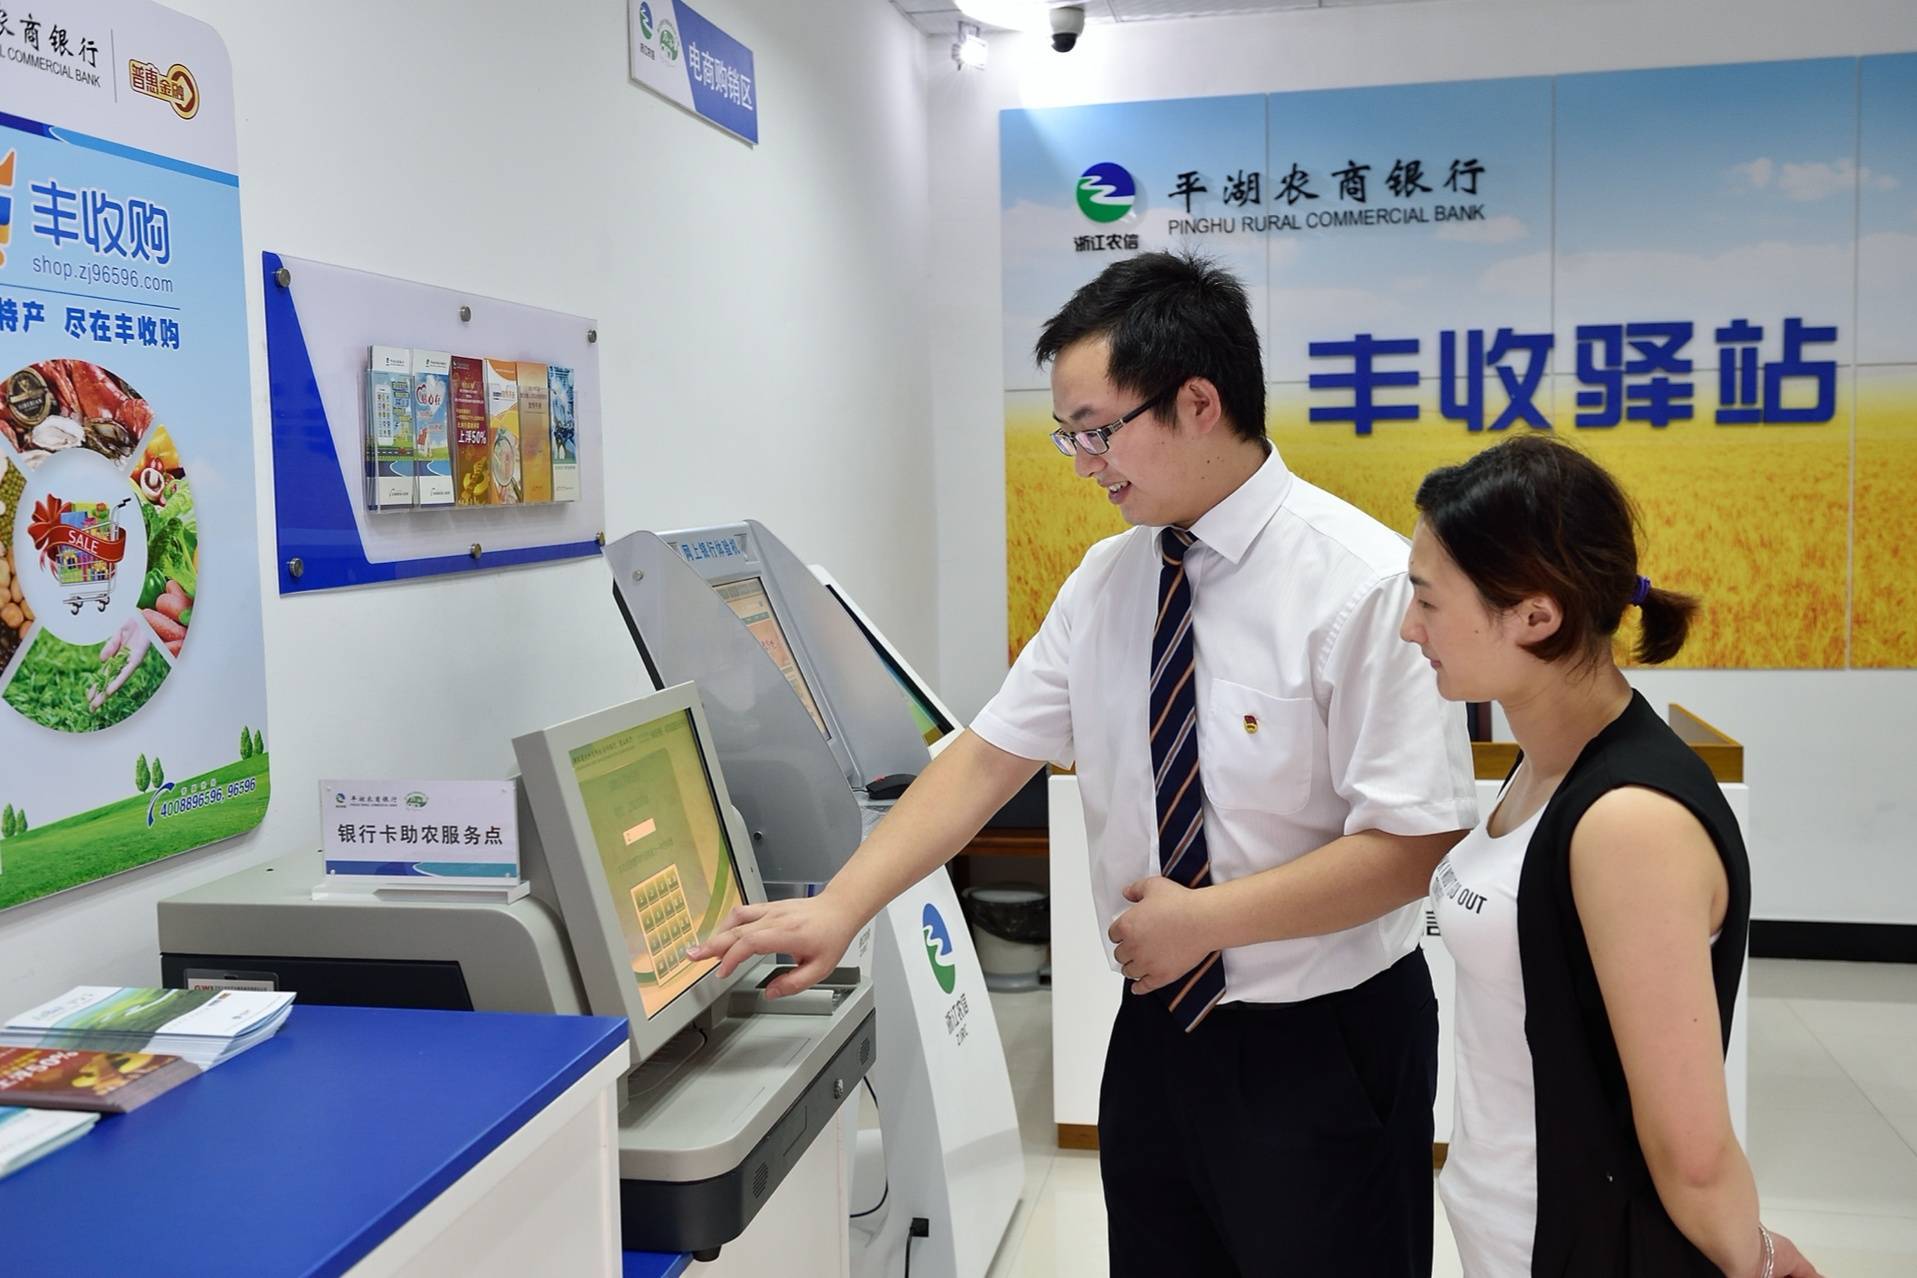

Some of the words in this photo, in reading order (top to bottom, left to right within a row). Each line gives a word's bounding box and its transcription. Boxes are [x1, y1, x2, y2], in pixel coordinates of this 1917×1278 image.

[7, 47, 74, 80] COMMERCIAL
[75, 69, 101, 88] BANK
[131, 63, 185, 101] 普惠金融
[688, 42, 754, 111] 电商购销区
[1168, 159, 1487, 214] 平湖农商银行
[31, 181, 172, 265] 丰收购
[1168, 218, 1236, 236] PINGHU
[1242, 214, 1301, 231] RURAL
[1306, 206, 1430, 229] COMMERCIAL
[1435, 204, 1487, 222] BANK
[1073, 233, 1139, 252] 浙江农信
[32, 255, 174, 292] shop.zj96596.com
[64, 307, 181, 350] 尽在丰收购
[1308, 317, 1838, 436] 丰收驿站
[68, 530, 99, 554] SALE
[227, 778, 256, 798] 96596
[338, 823, 503, 845] 银行卡助农服务点
[1457, 888, 1487, 914] OUT
